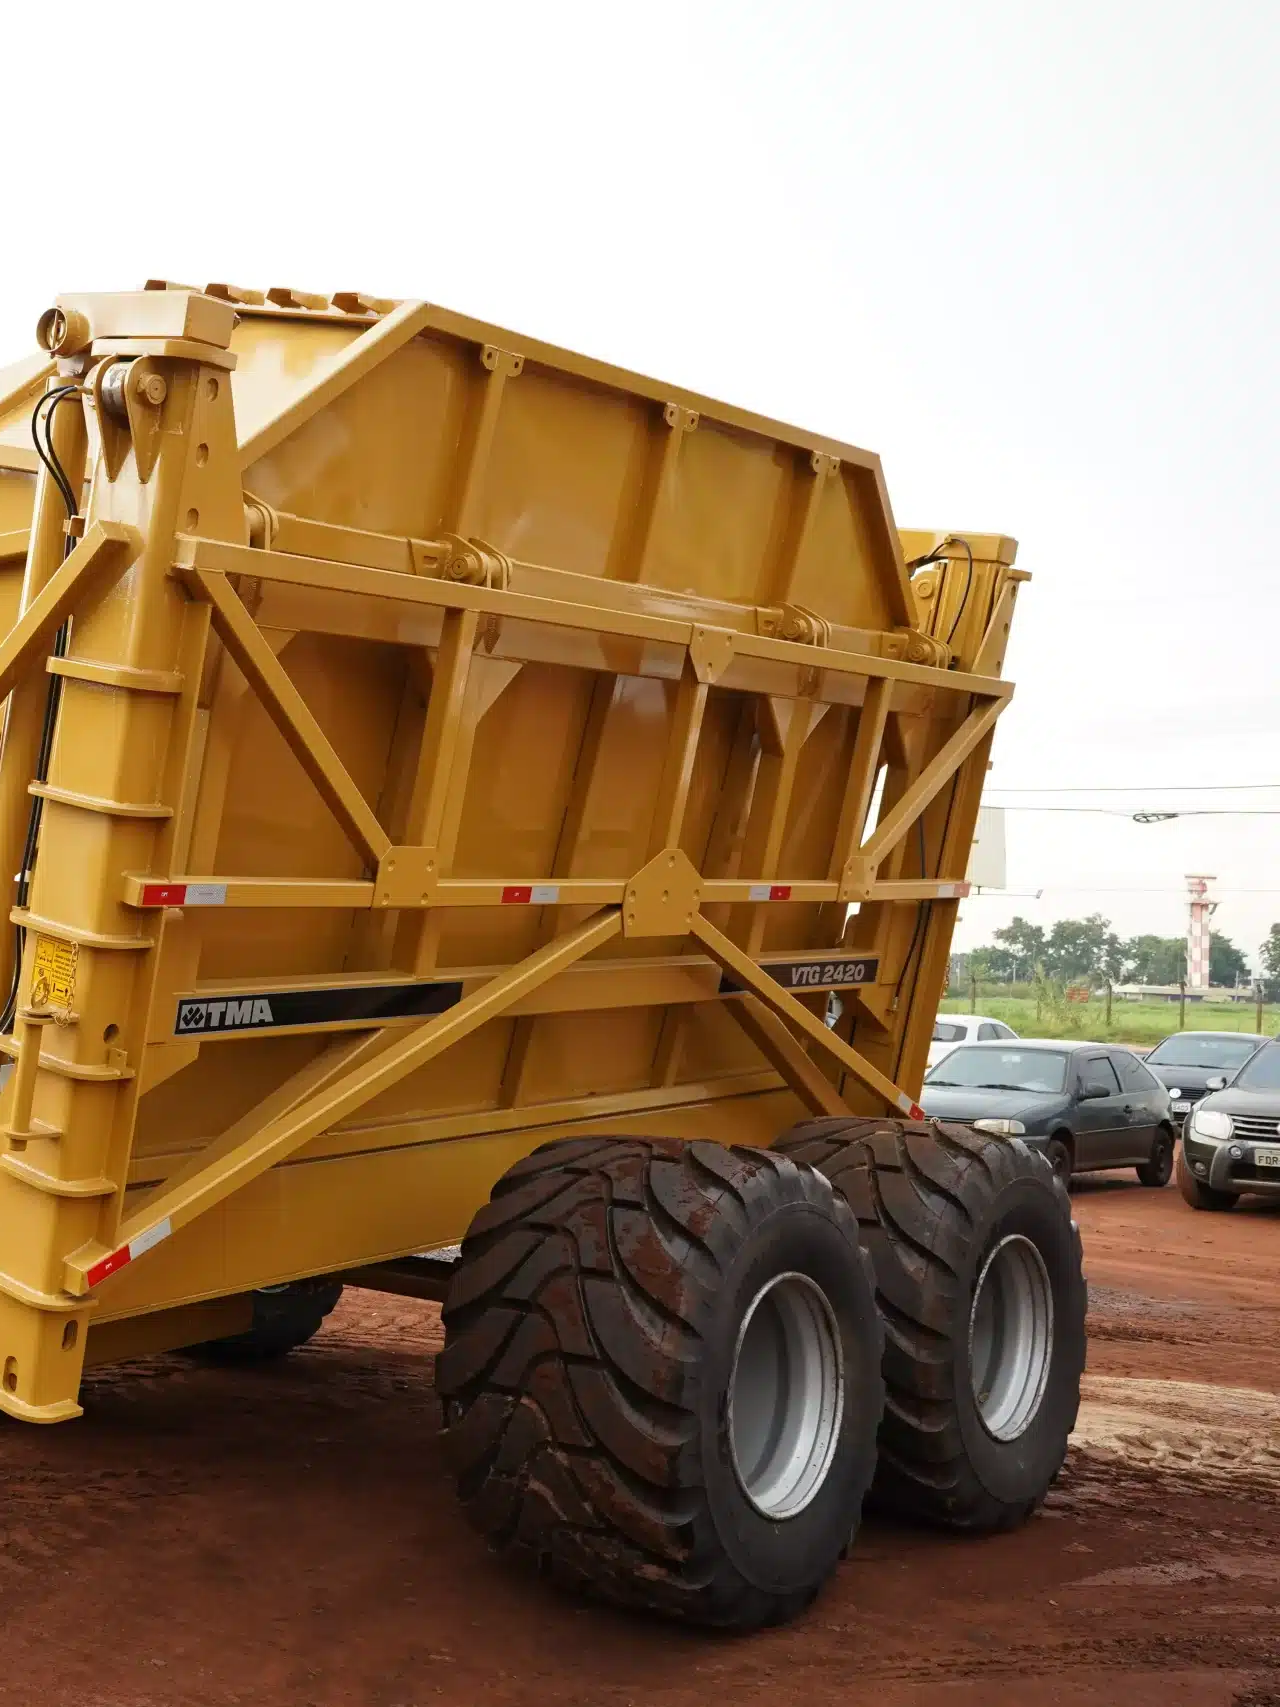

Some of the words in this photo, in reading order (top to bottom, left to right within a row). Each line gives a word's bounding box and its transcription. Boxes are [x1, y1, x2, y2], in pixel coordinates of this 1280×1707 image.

[792, 966, 821, 985] VTG
[822, 964, 865, 983] 2420
[207, 999, 274, 1027] TMA
